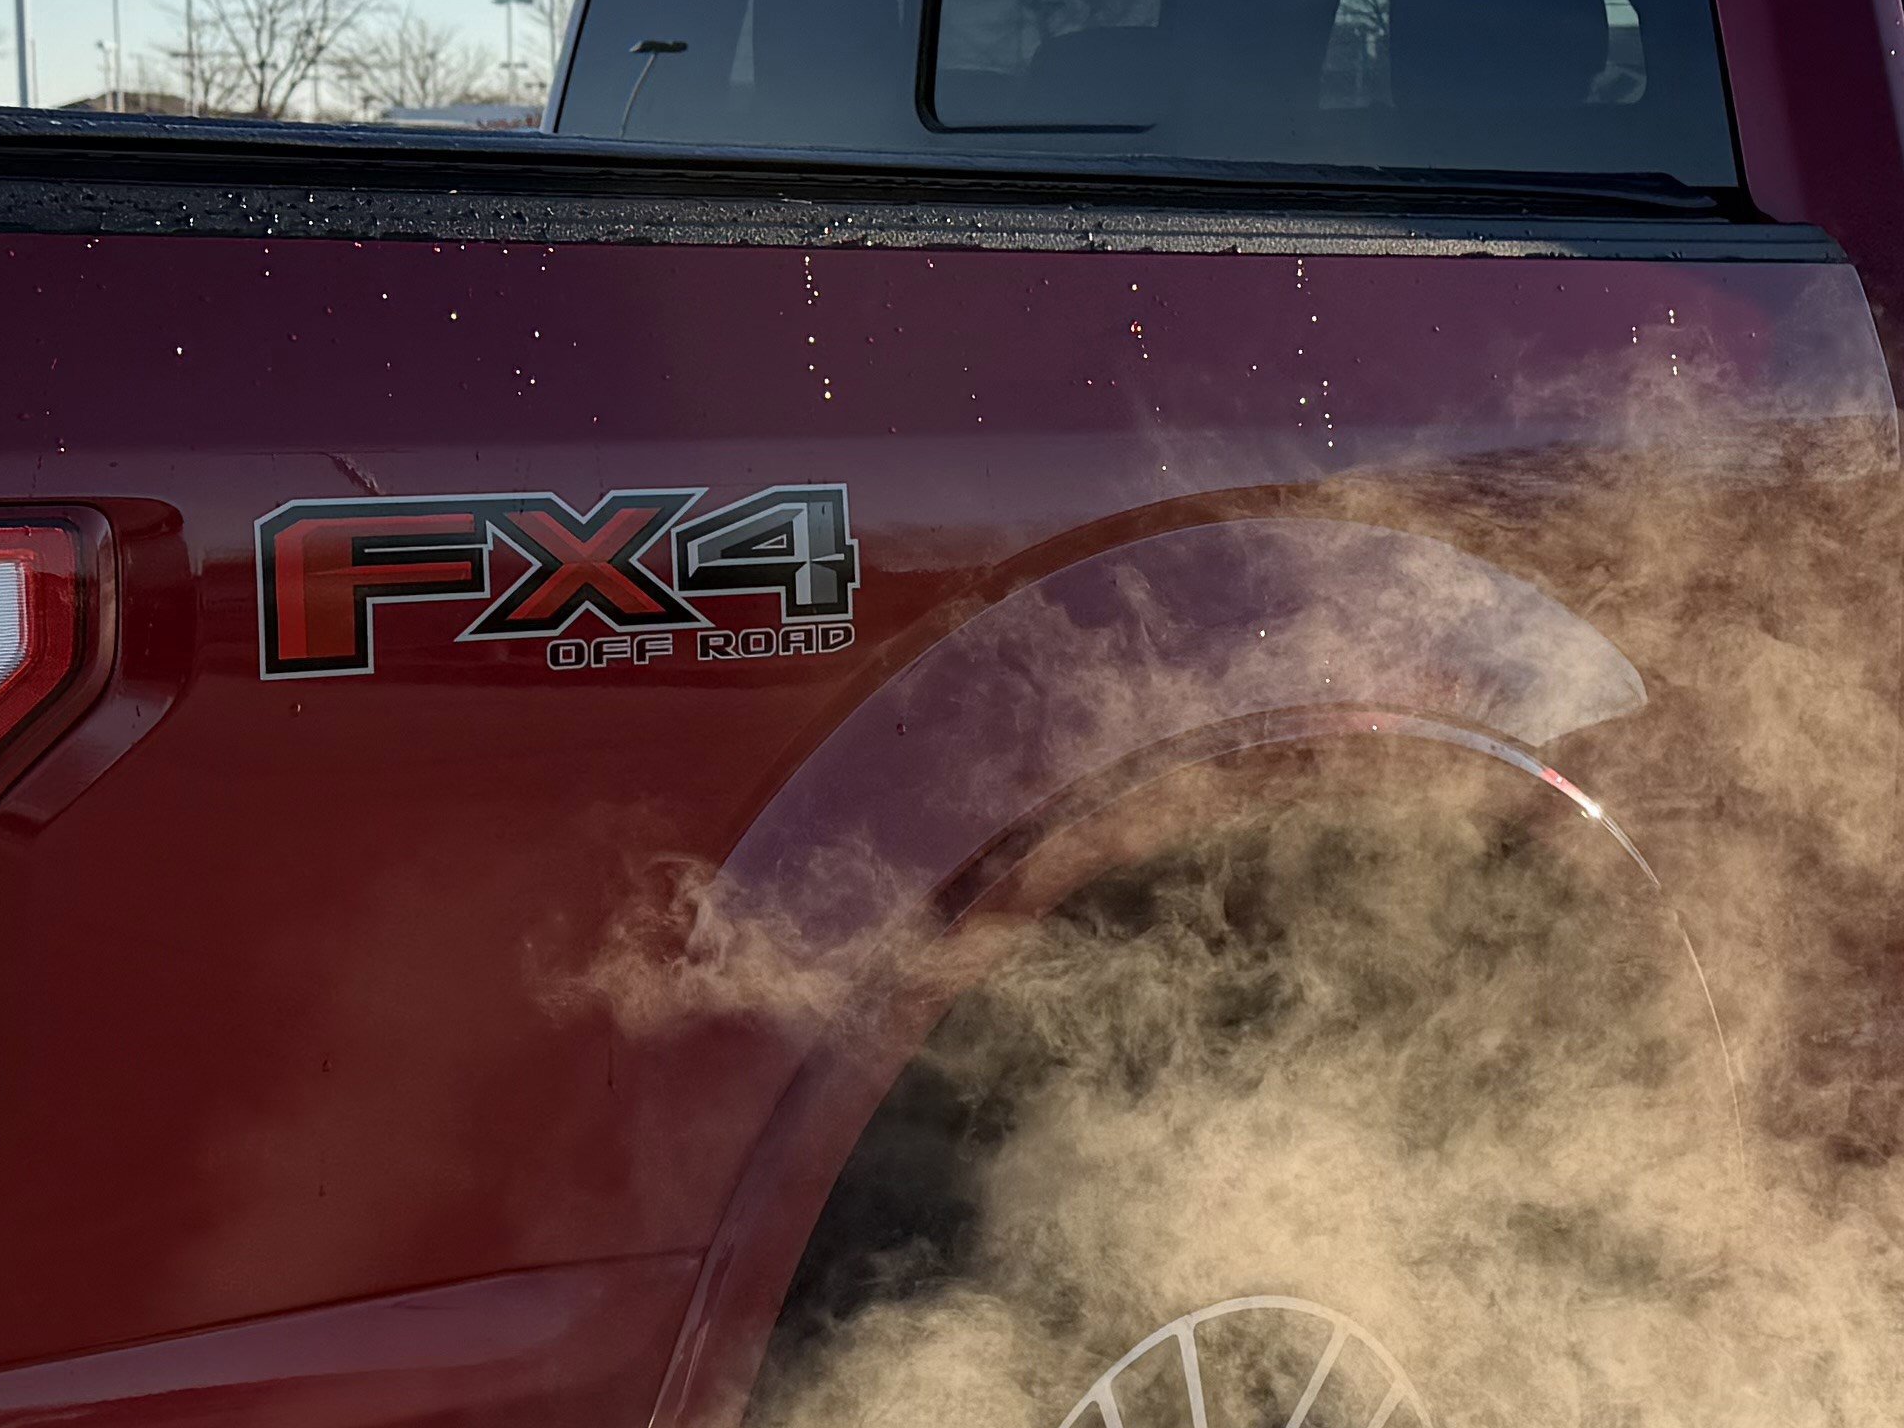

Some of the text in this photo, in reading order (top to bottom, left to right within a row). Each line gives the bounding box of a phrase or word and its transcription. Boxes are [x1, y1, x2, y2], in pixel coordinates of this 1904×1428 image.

[253, 482, 861, 680] FX4
[546, 623, 856, 670] OFF ROAD
